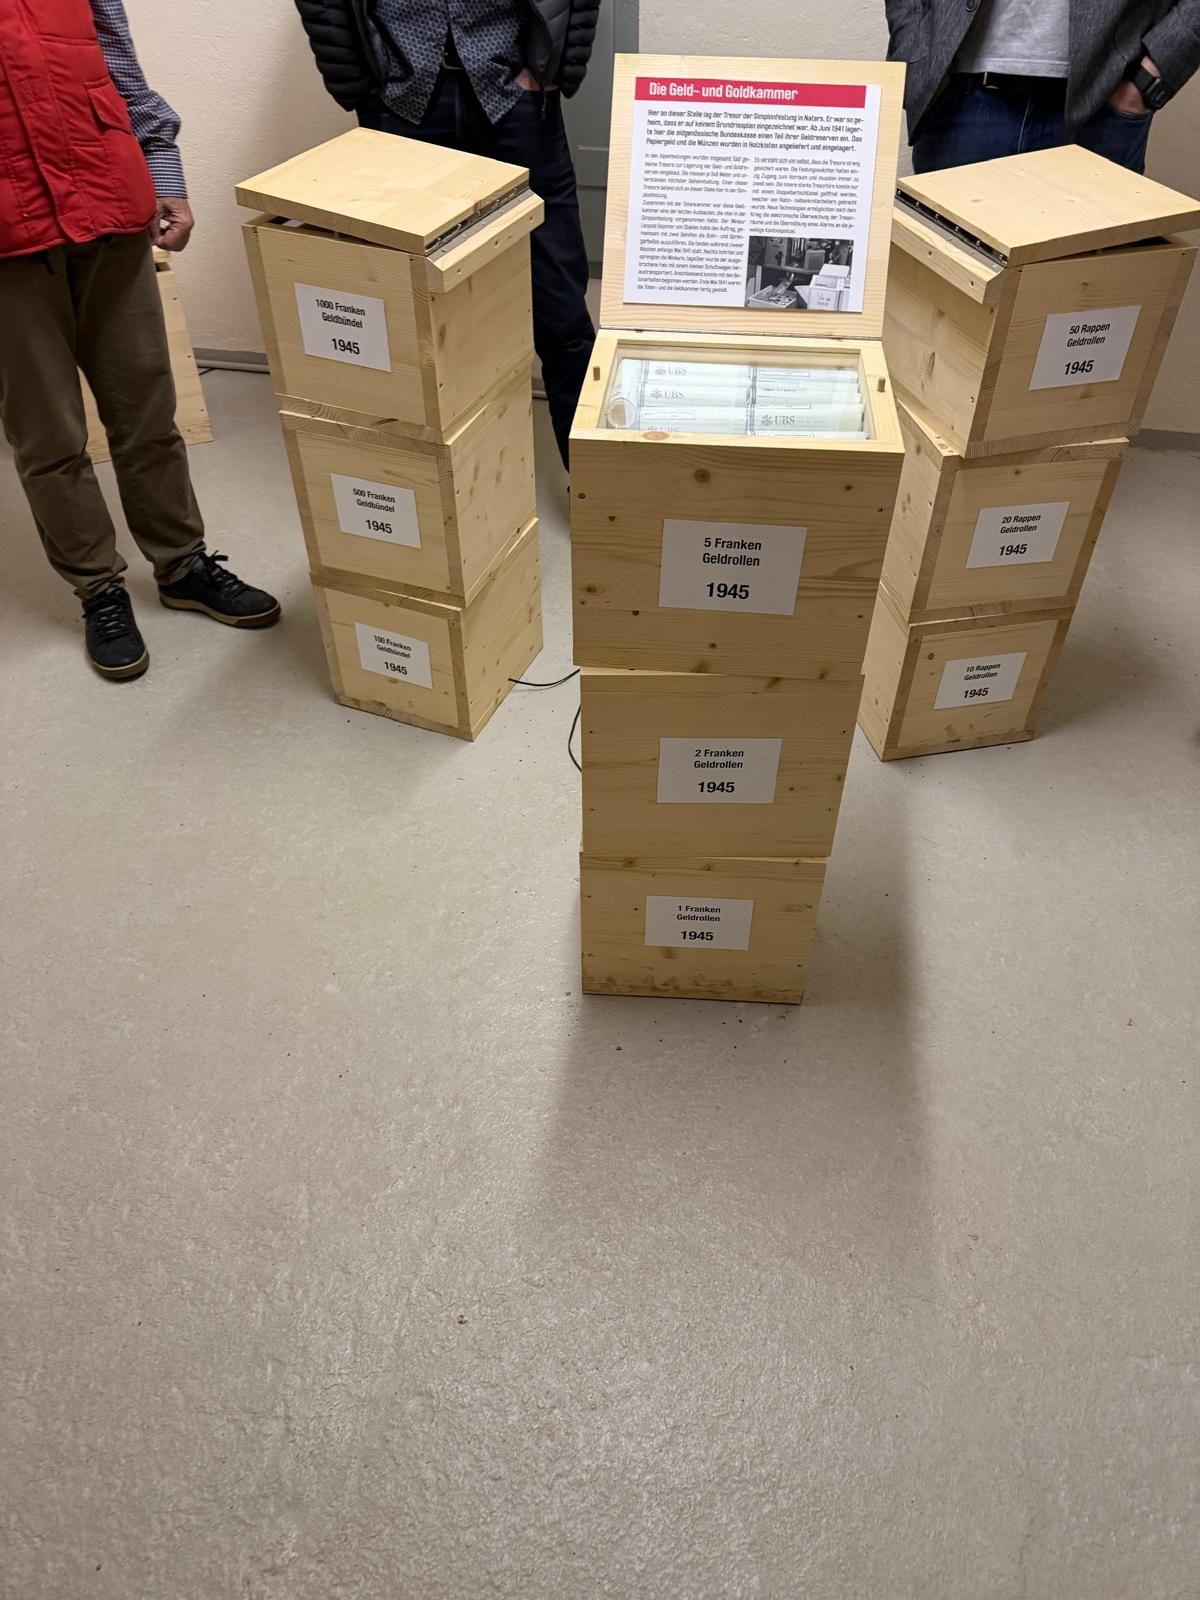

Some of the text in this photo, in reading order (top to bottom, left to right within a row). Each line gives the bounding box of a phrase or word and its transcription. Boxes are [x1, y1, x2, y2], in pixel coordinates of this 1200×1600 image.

[649, 82, 798, 100] Die Geld- und Goldkammer
[704, 111, 712, 119] lag
[753, 113, 797, 122] Simplonfestung
[316, 300, 365, 316] 1000 Franken
[322, 312, 363, 328] Geldbündel
[1069, 323, 1110, 334] 50 Rappen
[332, 338, 359, 354] 1945
[1067, 336, 1105, 347] Geldrollen
[668, 367, 687, 376] UBS
[1065, 360, 1094, 375] 1945
[664, 390, 684, 399] UBS
[775, 416, 795, 425] UBS
[353, 488, 395, 503] 500 Franken
[357, 499, 395, 512] Geldbündel
[1013, 515, 1041, 523] Rappen
[366, 520, 392, 533] 1945
[1000, 524, 1037, 534] Geldrollen
[704, 537, 762, 550] 5 Franken
[1000, 544, 1027, 556] 1945
[703, 553, 760, 566] Geldrollen
[707, 582, 749, 599] 1945
[374, 635, 411, 651] 100 Franken
[377, 644, 410, 659] Geldbündel
[384, 661, 407, 675] 1945
[964, 672, 998, 680] Geldrollen
[964, 688, 989, 698] 1945
[698, 782, 735, 792] 1945
[681, 931, 714, 941] 1945
